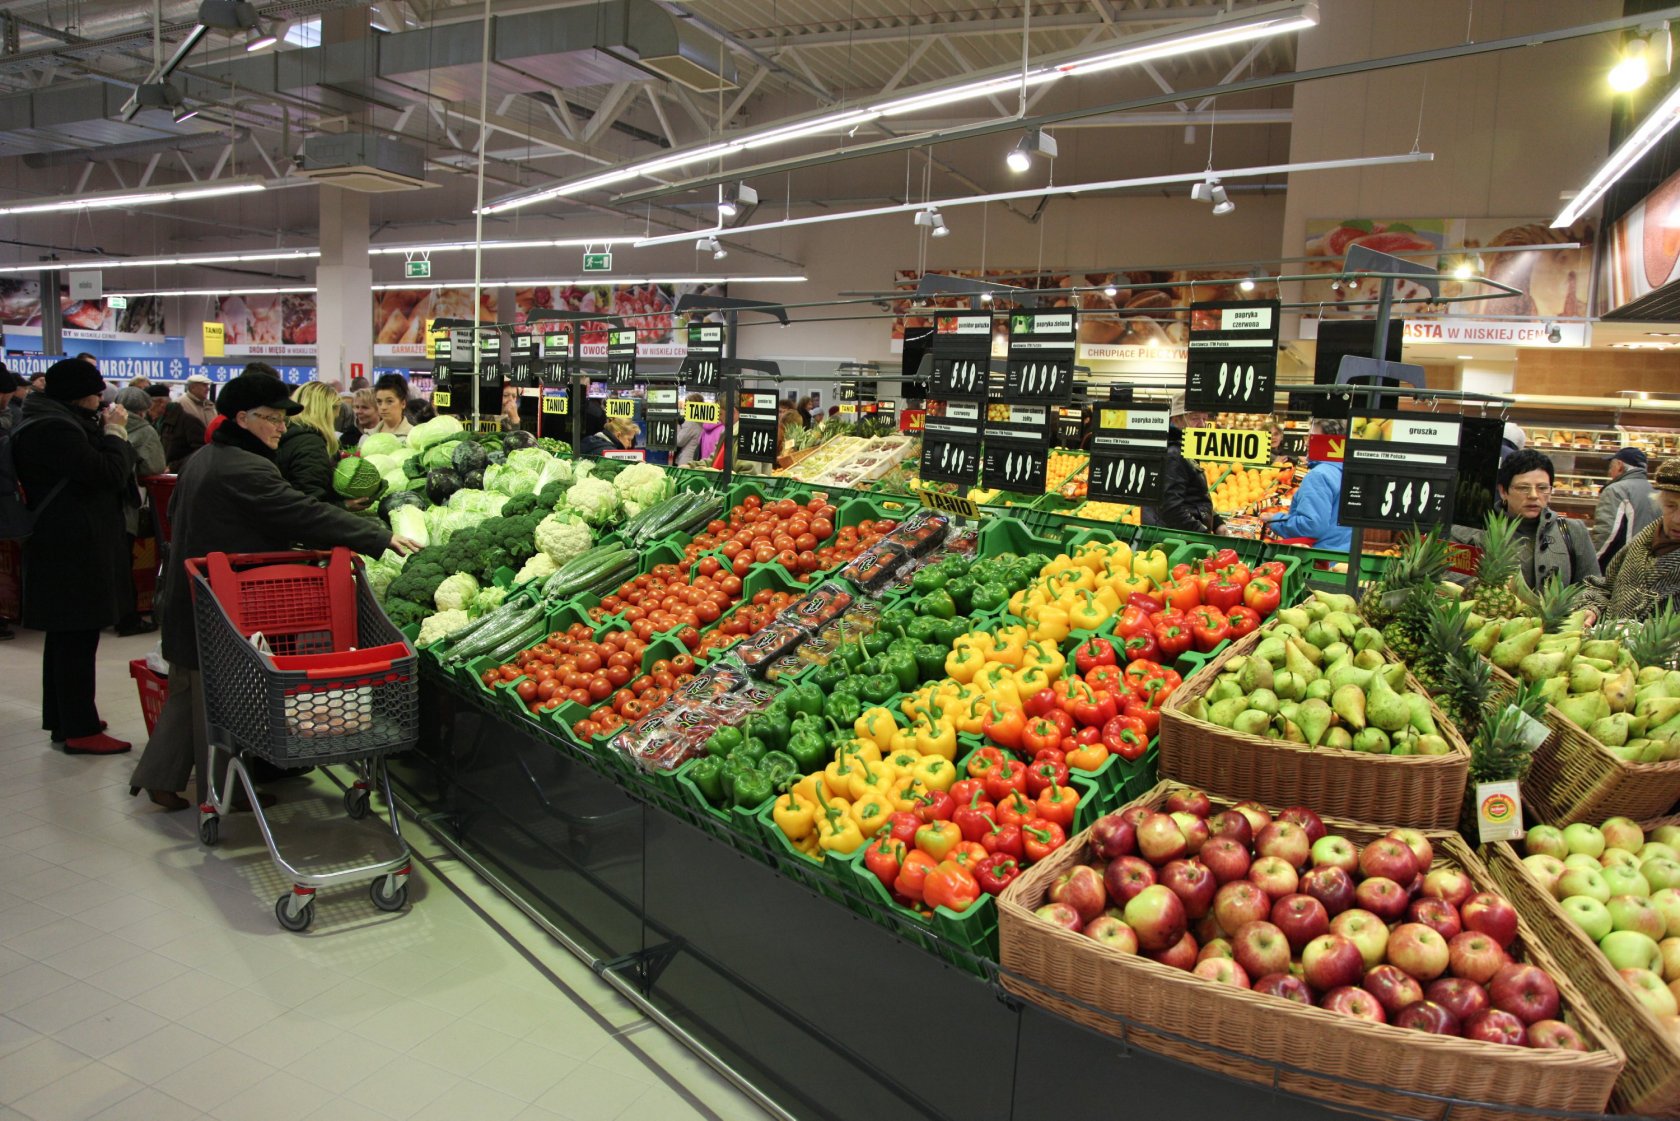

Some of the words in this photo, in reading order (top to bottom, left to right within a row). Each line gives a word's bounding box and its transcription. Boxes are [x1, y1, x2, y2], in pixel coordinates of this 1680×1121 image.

[1232, 320, 1260, 328] czerwona
[1234, 311, 1258, 319] papryka
[1447, 328, 1460, 339] W
[1464, 328, 1513, 340] NISKIEJ
[1087, 348, 1137, 358] CHRUPIĄCE
[101, 358, 164, 377] MROŻONKI
[950, 360, 976, 392] 5.49
[1020, 363, 1057, 394] 10.99
[1217, 362, 1255, 401] 9.99
[435, 393, 449, 405] TANIO
[546, 399, 565, 412] TANIO
[609, 400, 631, 416] TANIO
[689, 404, 715, 421] TANIO
[1131, 416, 1151, 424] papryka
[1409, 427, 1437, 436] gruszka
[1193, 431, 1259, 460] TANIO
[941, 443, 965, 474] 5.49
[1005, 451, 1032, 483] 4.99
[1104, 458, 1146, 494] 10.99
[924, 491, 973, 516] TANIO
[1381, 481, 1430, 518] 5.49
